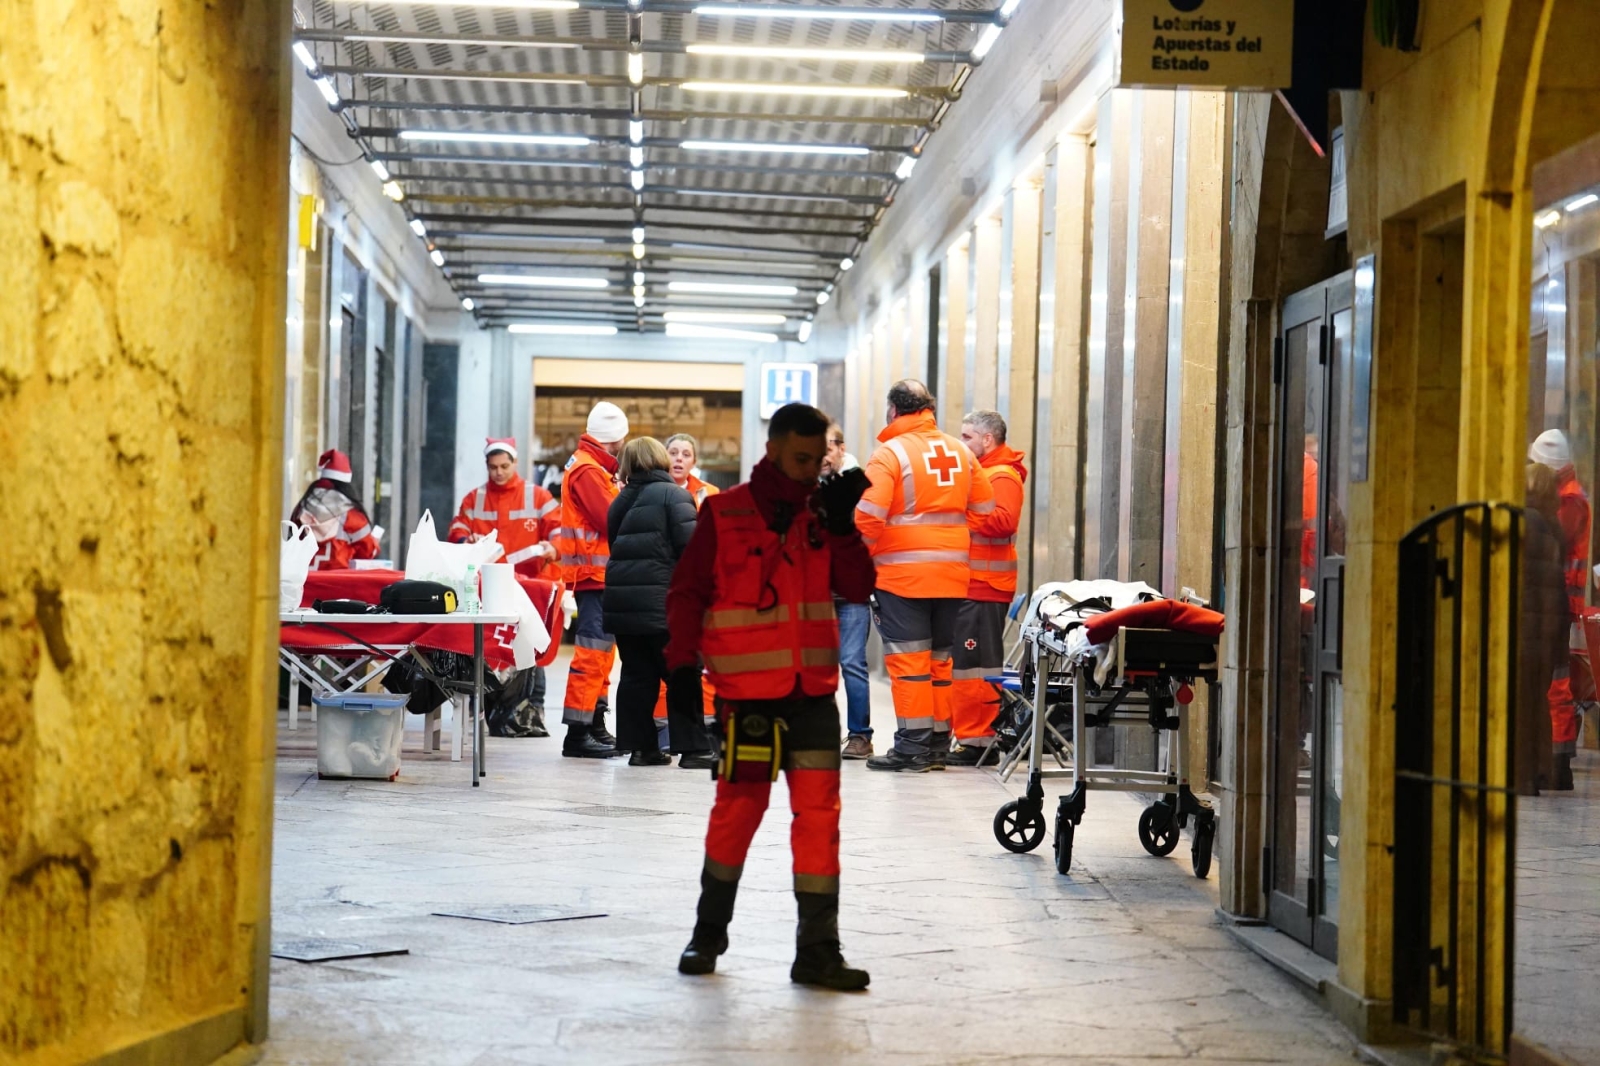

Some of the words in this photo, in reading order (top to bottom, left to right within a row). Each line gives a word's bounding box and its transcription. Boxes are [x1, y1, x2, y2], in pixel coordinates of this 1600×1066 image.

[1226, 20, 1236, 35] y
[1153, 37, 1231, 53] Apuestas
[1236, 37, 1261, 52] del
[1152, 56, 1209, 71] Estado
[774, 370, 803, 401] H
